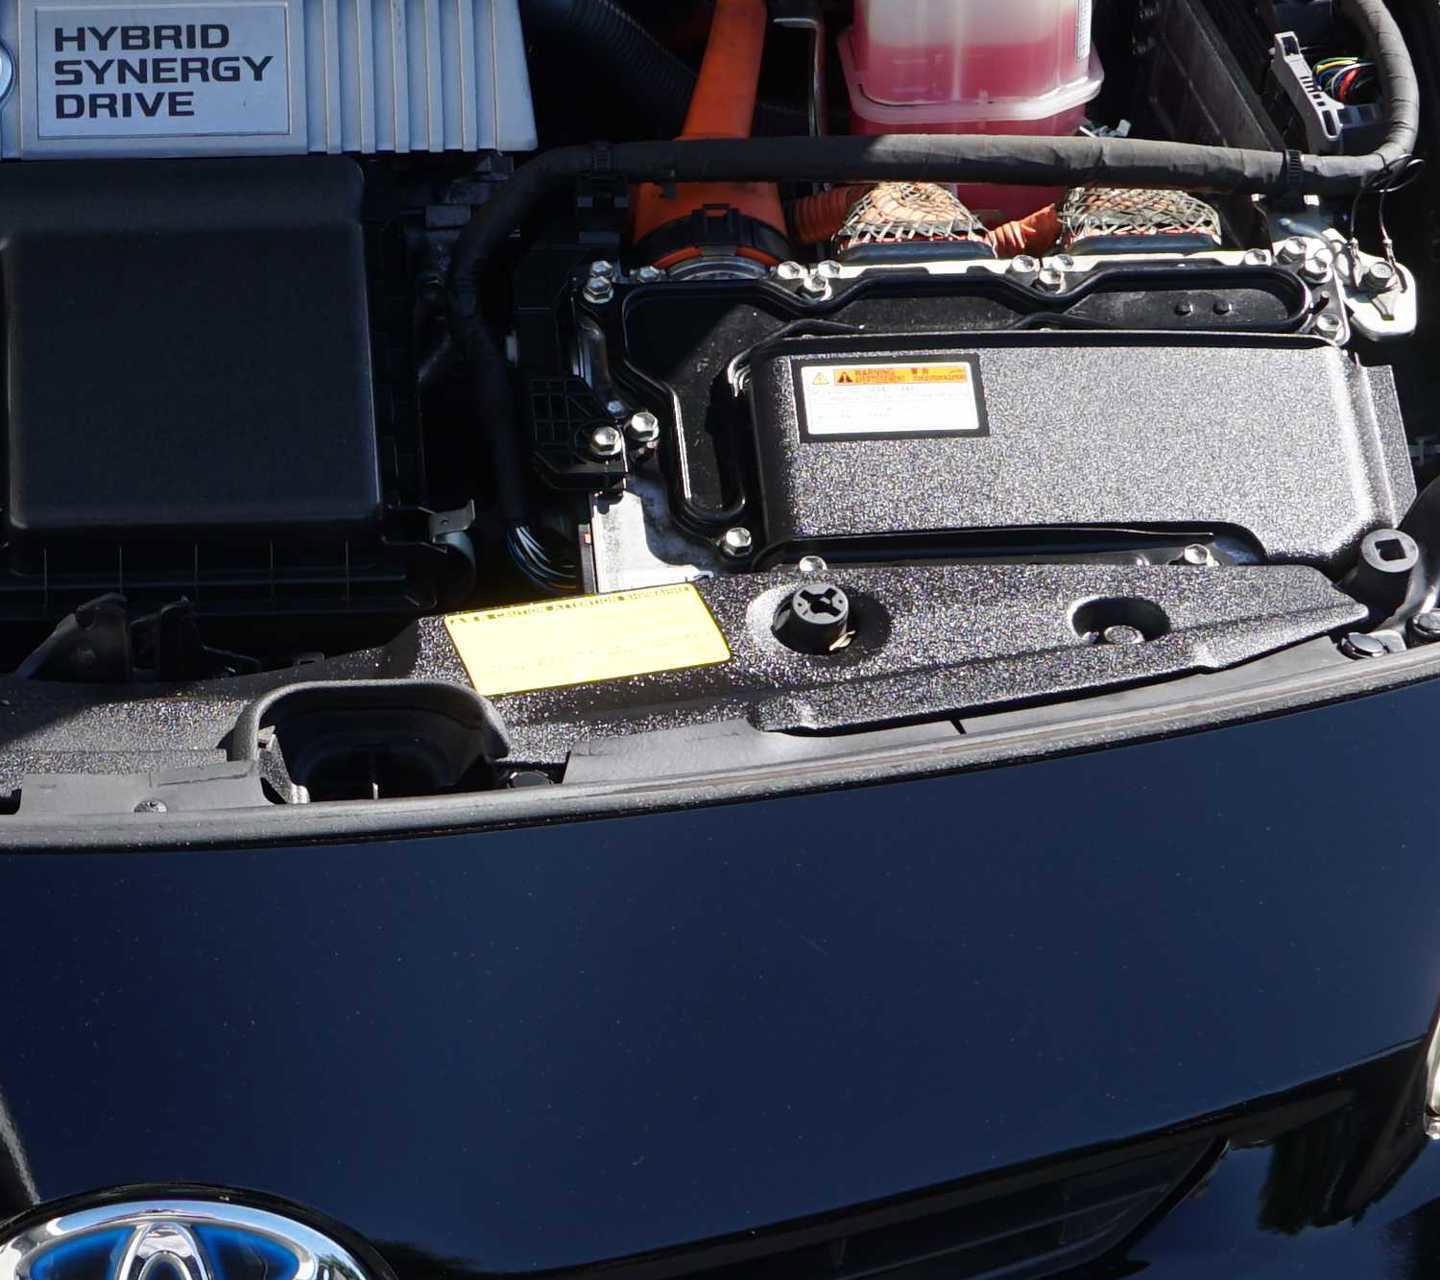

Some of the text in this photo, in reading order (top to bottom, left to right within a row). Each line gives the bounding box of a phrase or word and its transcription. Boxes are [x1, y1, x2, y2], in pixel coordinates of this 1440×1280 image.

[54, 24, 229, 52] HYBRID
[55, 56, 274, 85] SYNERGY
[55, 91, 194, 119] DRIVE
